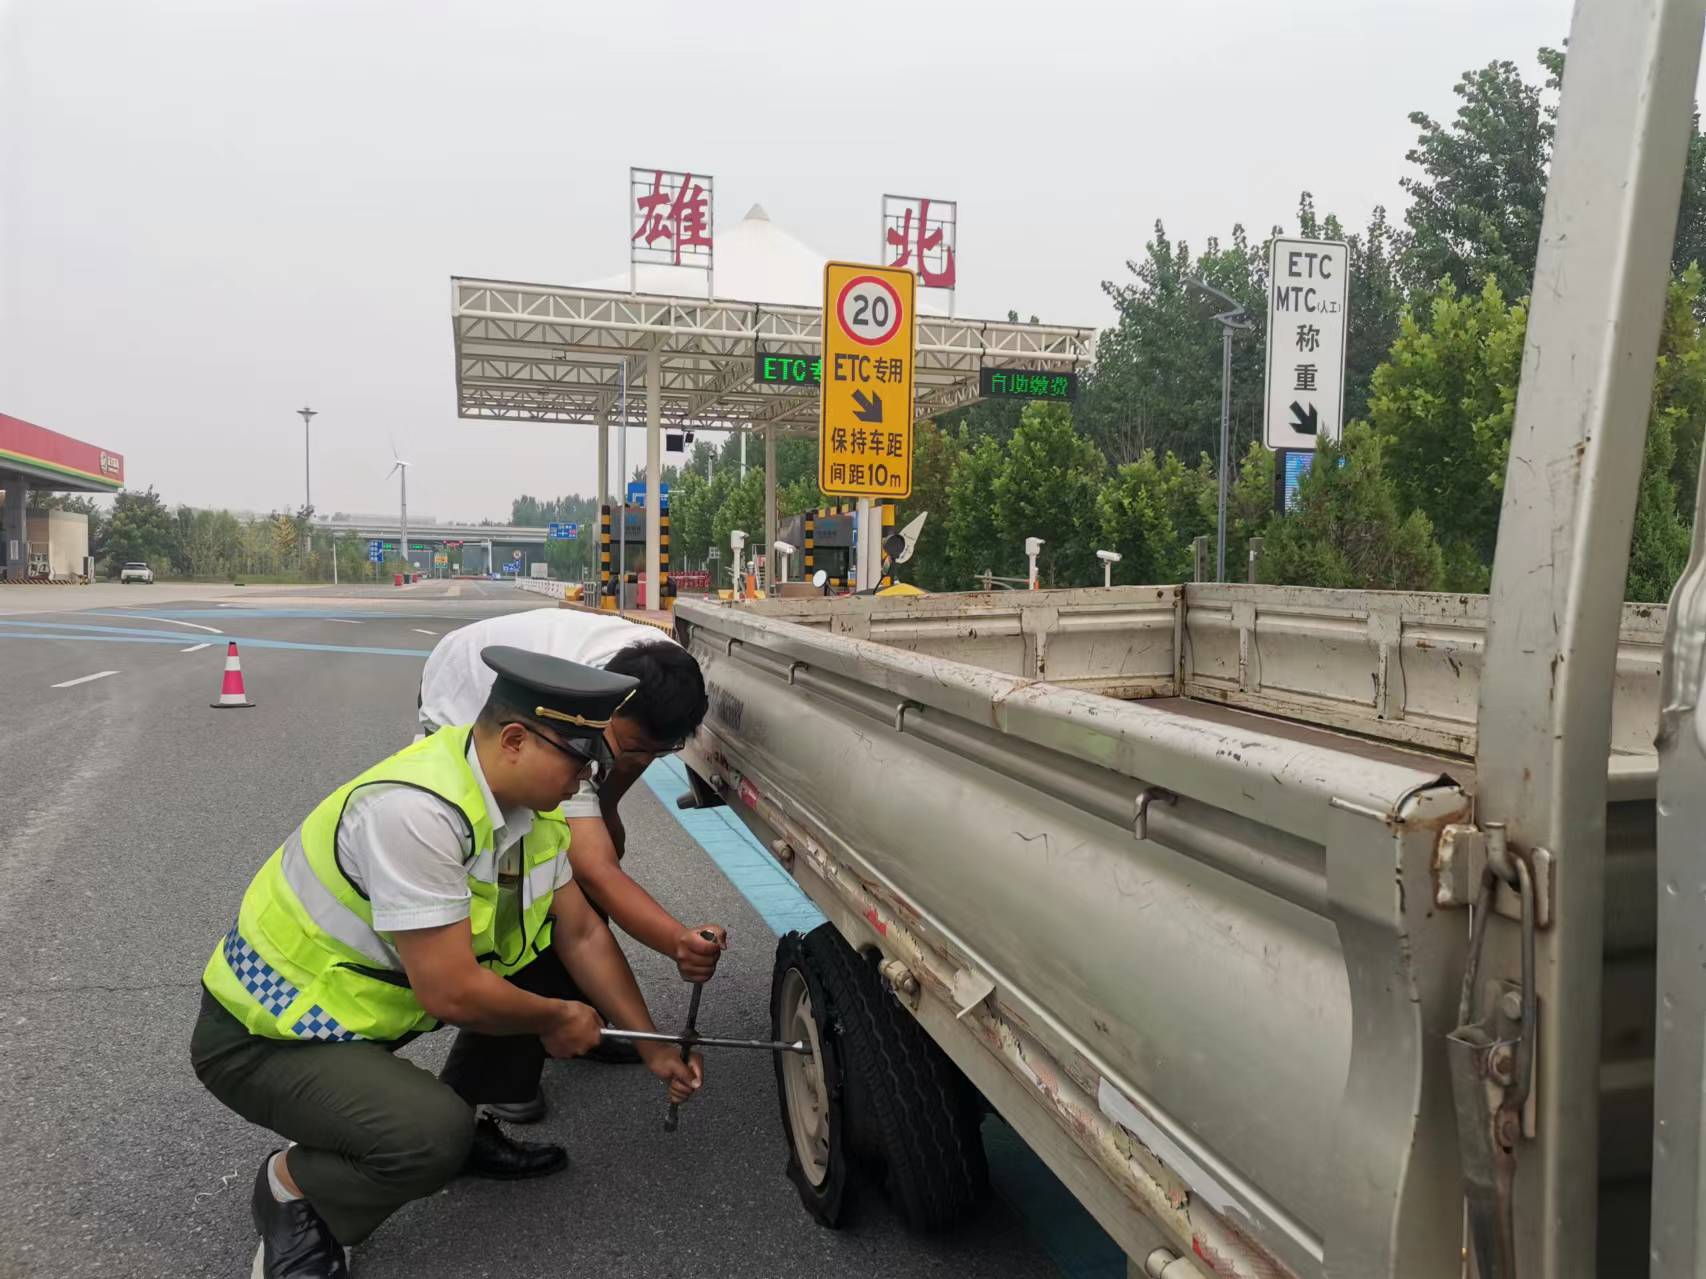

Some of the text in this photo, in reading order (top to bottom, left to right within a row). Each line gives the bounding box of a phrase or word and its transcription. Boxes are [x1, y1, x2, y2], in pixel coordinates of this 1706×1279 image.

[631, 170, 713, 266] 雄
[886, 199, 956, 287] 北
[1288, 251, 1332, 279] ETC
[852, 294, 889, 327] 20
[1293, 324, 1320, 392] 称重
[831, 427, 903, 458] 保持车距
[830, 463, 901, 488] 间距10m
